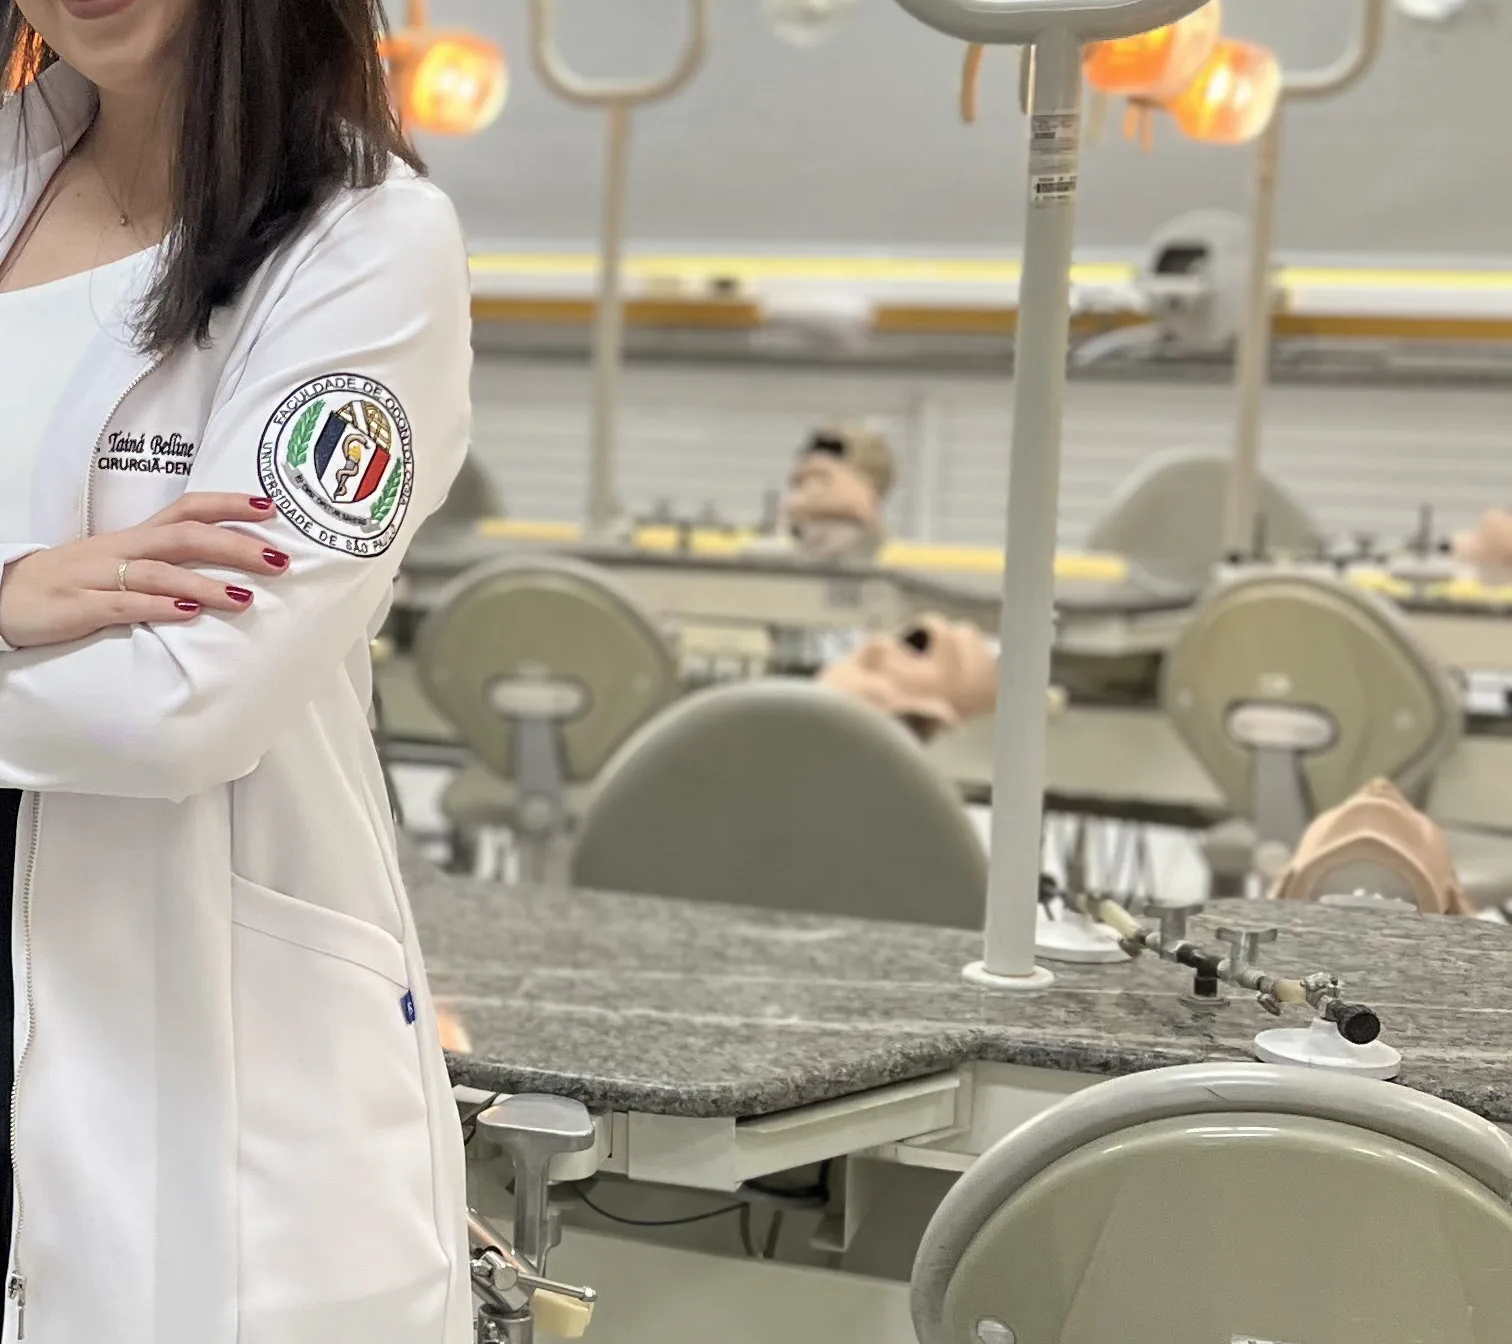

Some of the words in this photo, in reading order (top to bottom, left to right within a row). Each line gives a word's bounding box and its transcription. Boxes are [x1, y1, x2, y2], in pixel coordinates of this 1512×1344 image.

[273, 377, 356, 425] FACULDADE
[363, 381, 383, 396] DE
[108, 430, 145, 454] Tainá
[260, 442, 313, 532] UNIVERSIDADE
[319, 530, 338, 546] DE
[346, 538, 368, 554] SÃO
